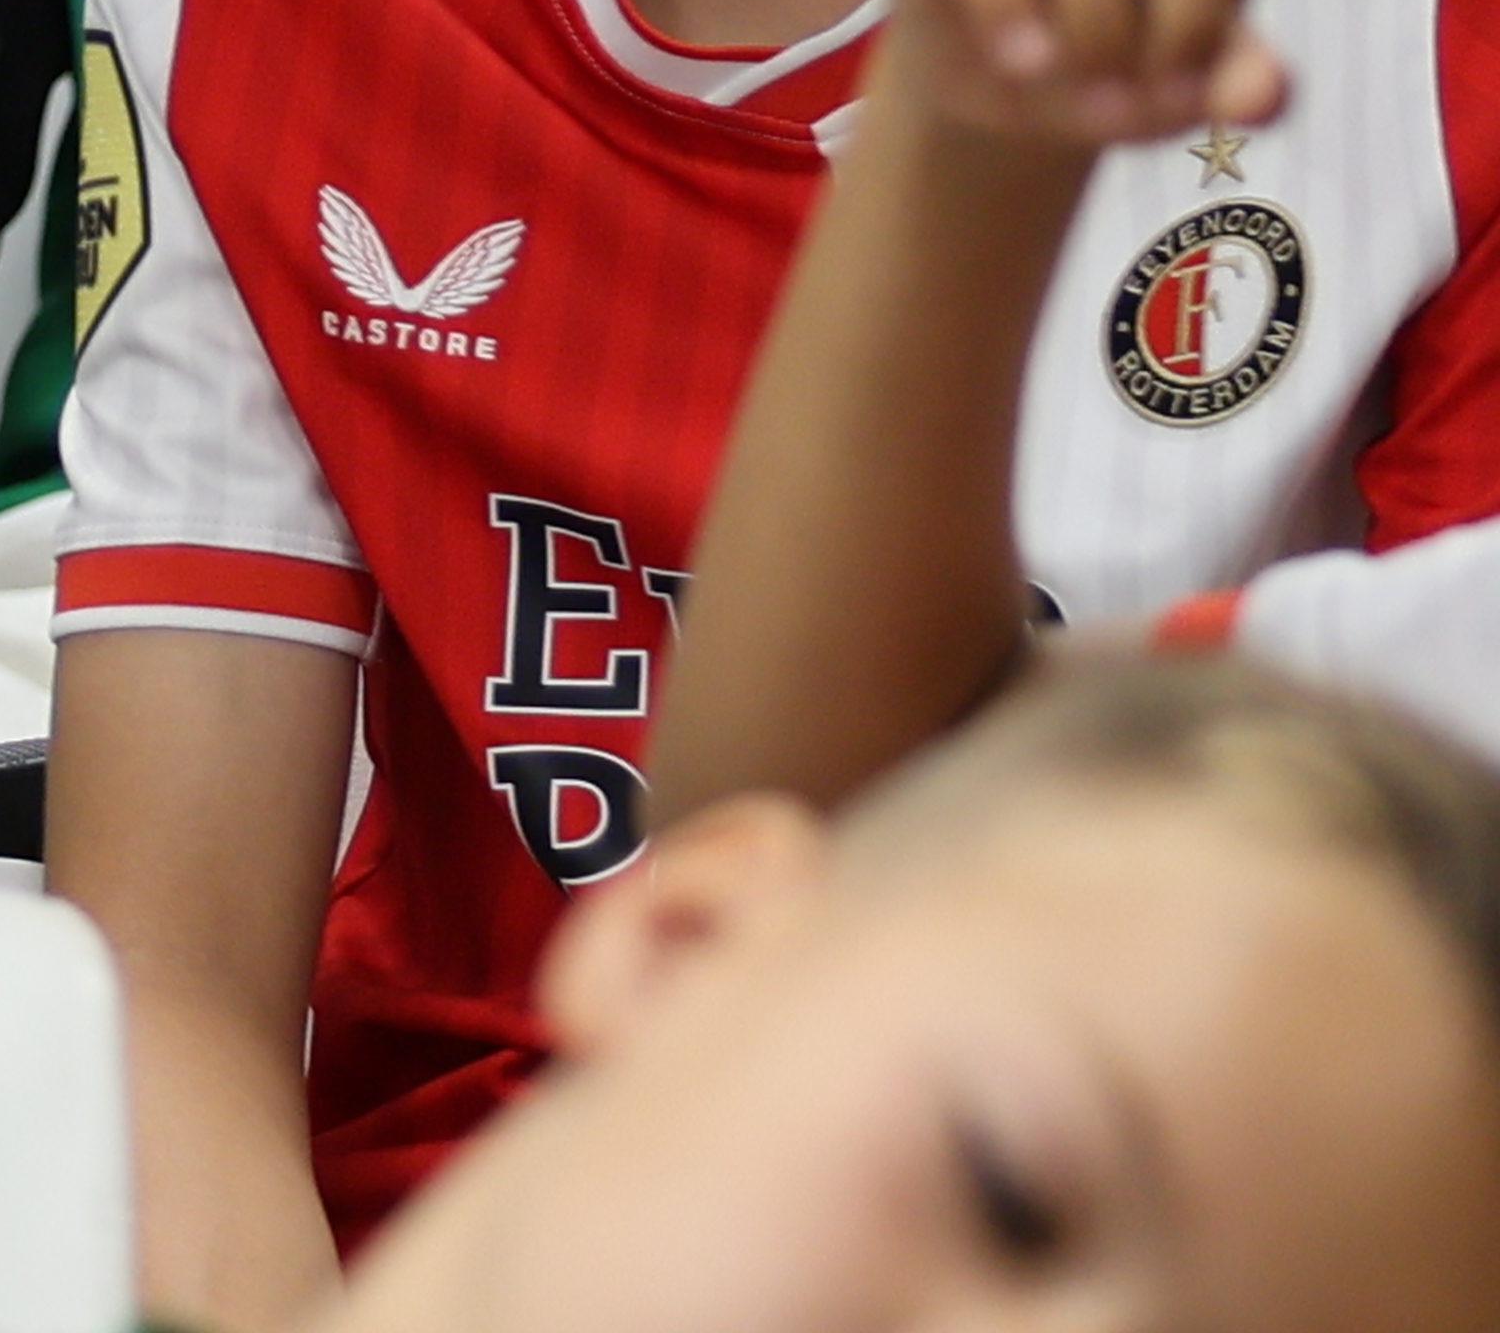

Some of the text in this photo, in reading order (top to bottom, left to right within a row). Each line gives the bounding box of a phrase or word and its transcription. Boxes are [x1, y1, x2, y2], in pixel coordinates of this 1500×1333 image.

[1123, 207, 1298, 295] FEYENOORD
[321, 309, 498, 361] CASTORE
[1113, 319, 1296, 416] ROTTERDAM
